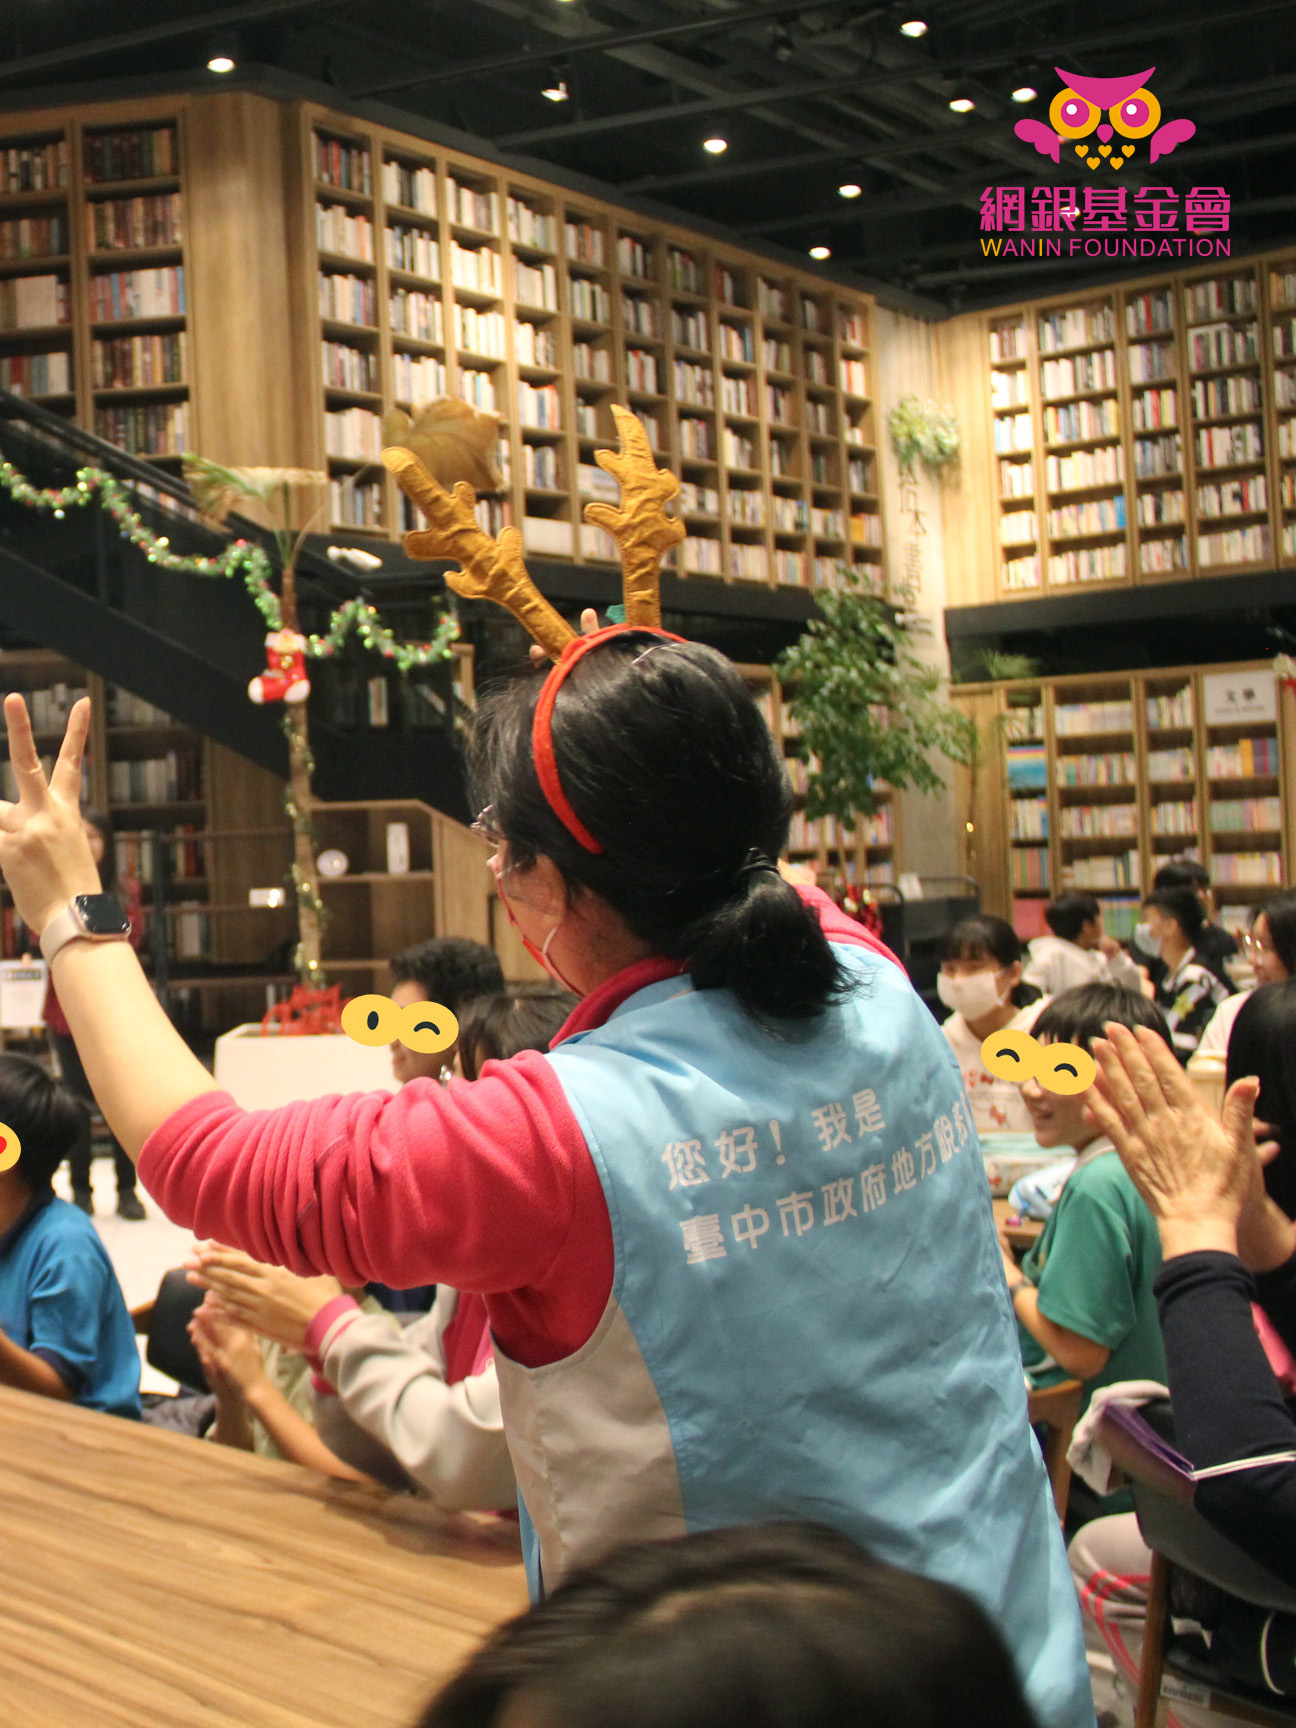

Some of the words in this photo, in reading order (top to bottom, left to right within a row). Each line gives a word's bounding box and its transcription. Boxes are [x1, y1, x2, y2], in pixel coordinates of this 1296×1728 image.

[679, 1090, 973, 1265] 臺中市政府地方稅務
